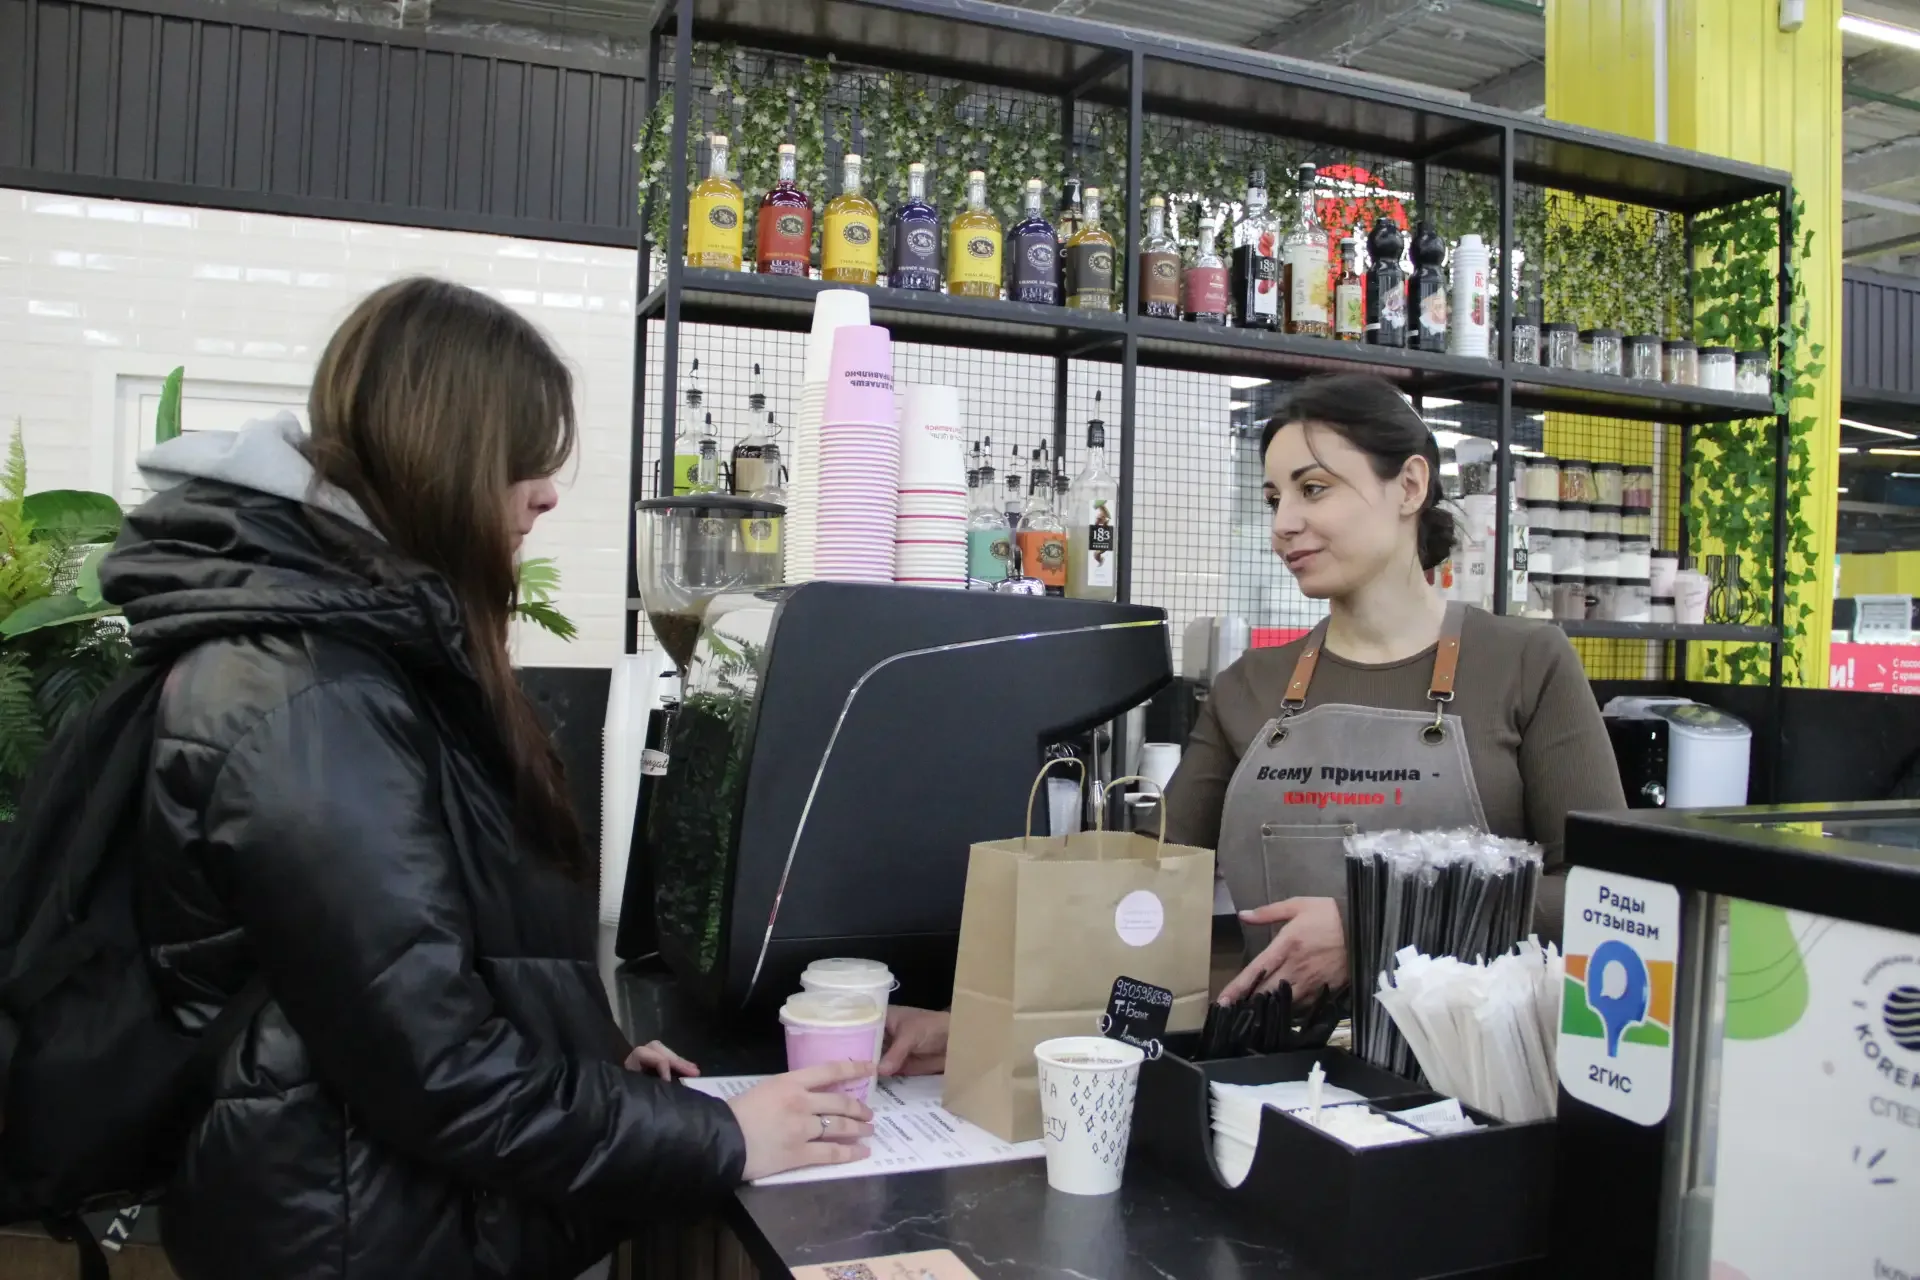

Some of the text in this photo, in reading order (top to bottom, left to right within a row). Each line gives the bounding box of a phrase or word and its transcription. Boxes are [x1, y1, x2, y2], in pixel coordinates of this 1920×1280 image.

[1257, 765, 1313, 785] Всему
[1320, 764, 1421, 787] причина
[1283, 788, 1385, 809] капучино
[1599, 885, 1646, 914] Рады
[1583, 908, 1660, 940] отзывам
[1588, 1064, 1632, 1094] 2ГИС
[1868, 1094, 1920, 1130] СПЕ
